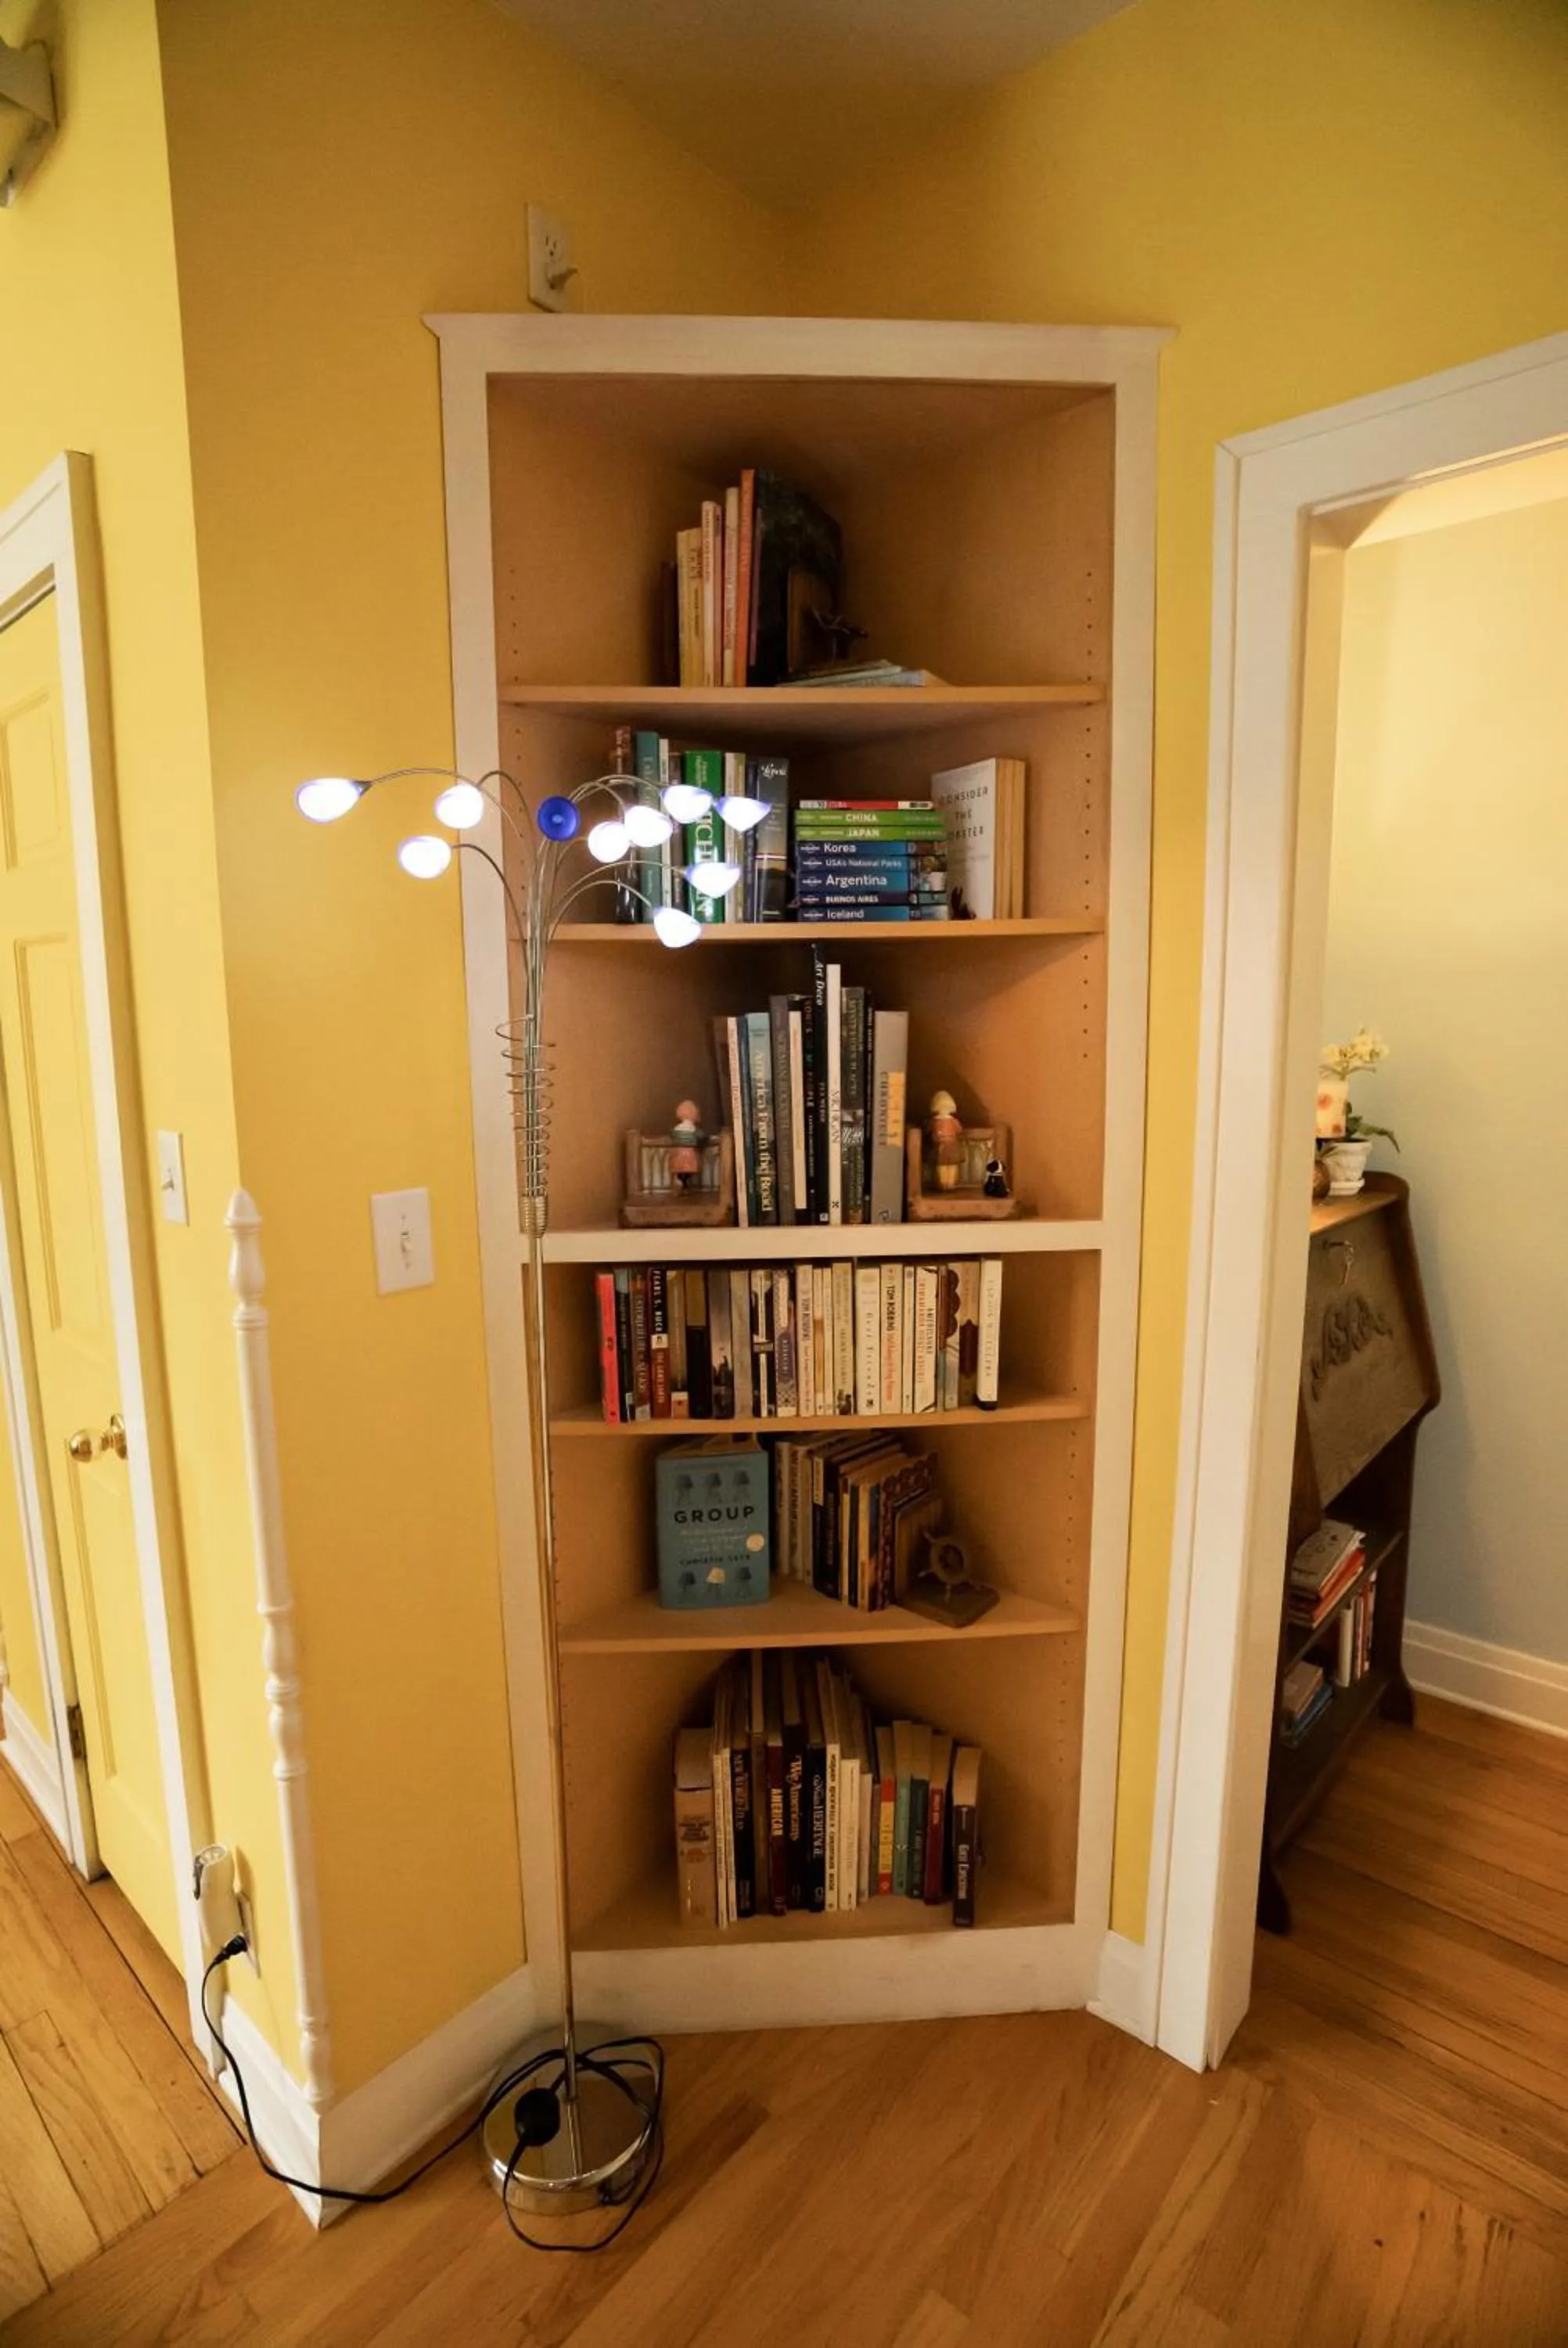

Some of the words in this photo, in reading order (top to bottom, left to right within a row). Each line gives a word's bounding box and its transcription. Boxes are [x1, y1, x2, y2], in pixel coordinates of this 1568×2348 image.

[824, 843, 856, 852] Korea
[825, 874, 887, 888] Argentina
[827, 909, 865, 919] Iceland
[815, 960, 825, 978] Art
[815, 980, 825, 1006] Deco
[754, 1050, 769, 1109] America
[757, 1112, 769, 1149] From
[759, 1151, 771, 1174] the
[761, 1176, 773, 1212] Road
[886, 1285, 896, 1300] TOM
[674, 1506, 754, 1523] GROUP
